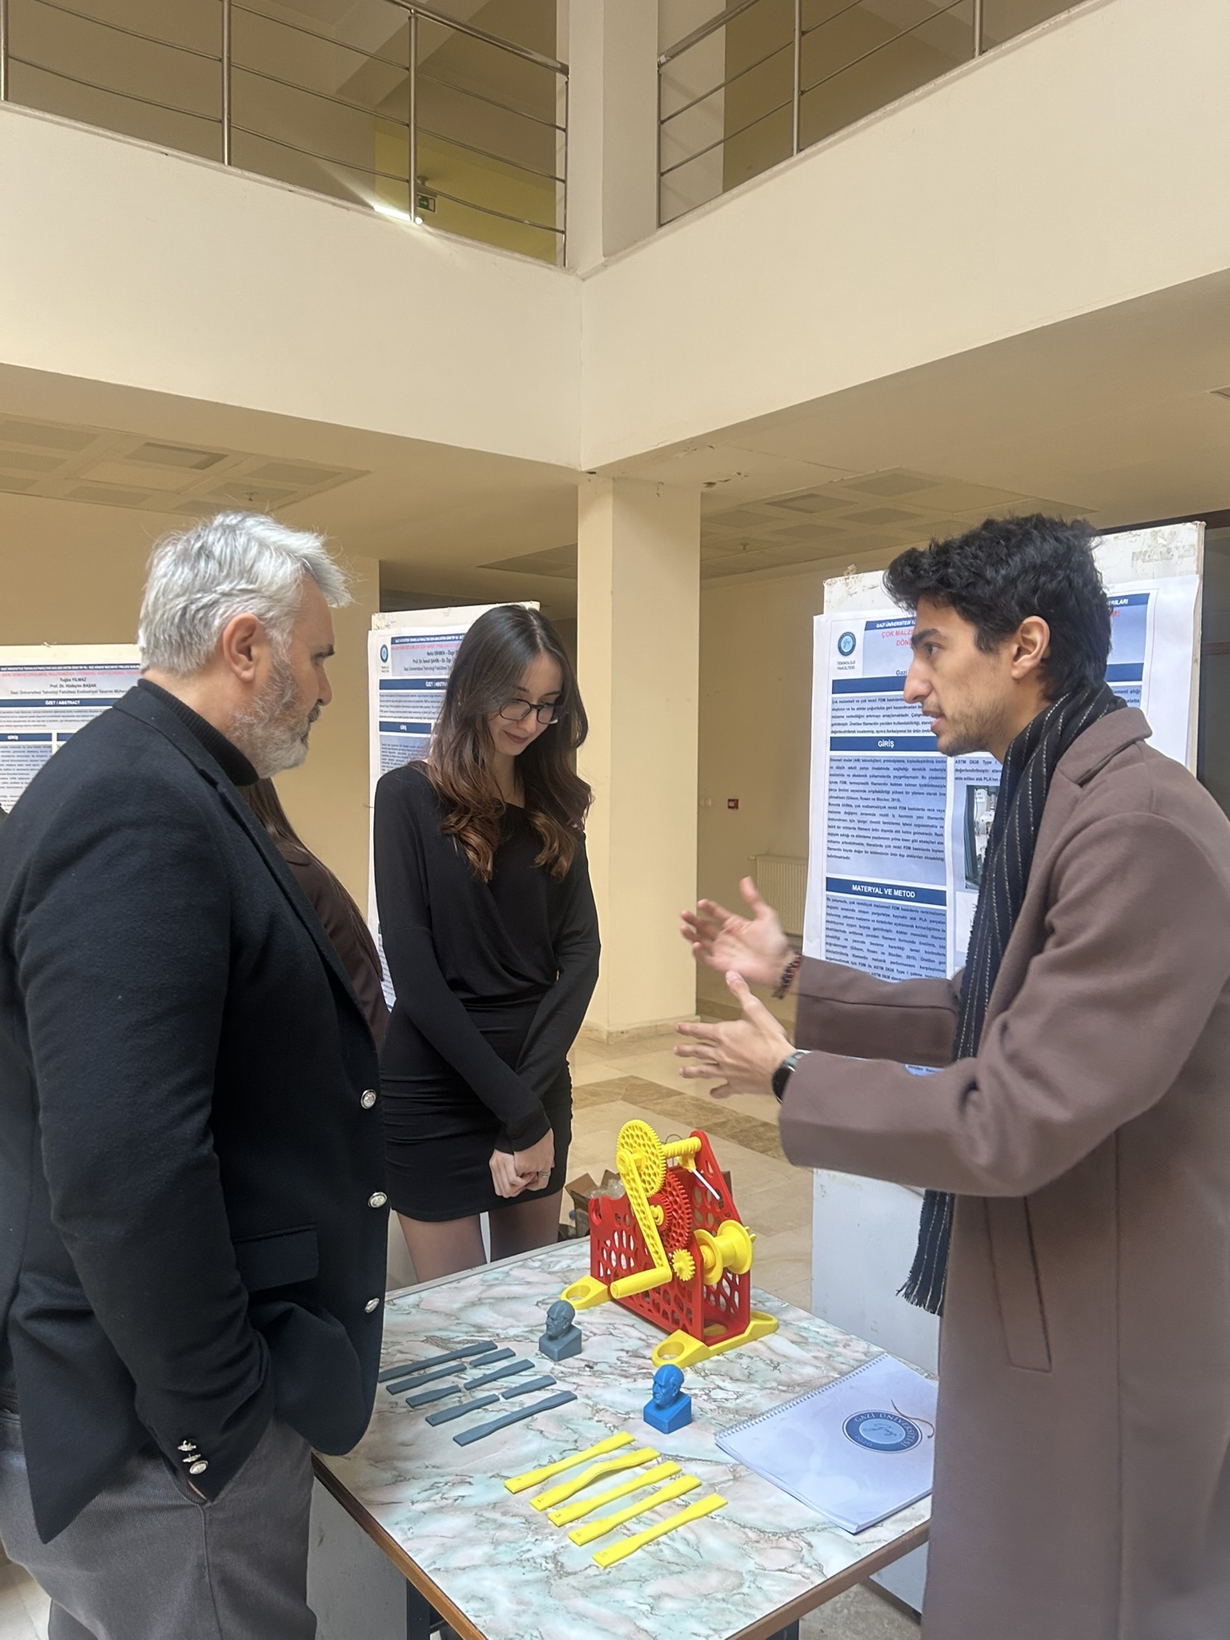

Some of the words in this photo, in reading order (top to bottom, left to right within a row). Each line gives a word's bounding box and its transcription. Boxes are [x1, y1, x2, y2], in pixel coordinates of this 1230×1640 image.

[878, 740, 894, 748] GİRİŞ
[852, 884, 882, 894] MATERYAL
[894, 889, 916, 898] METOD
